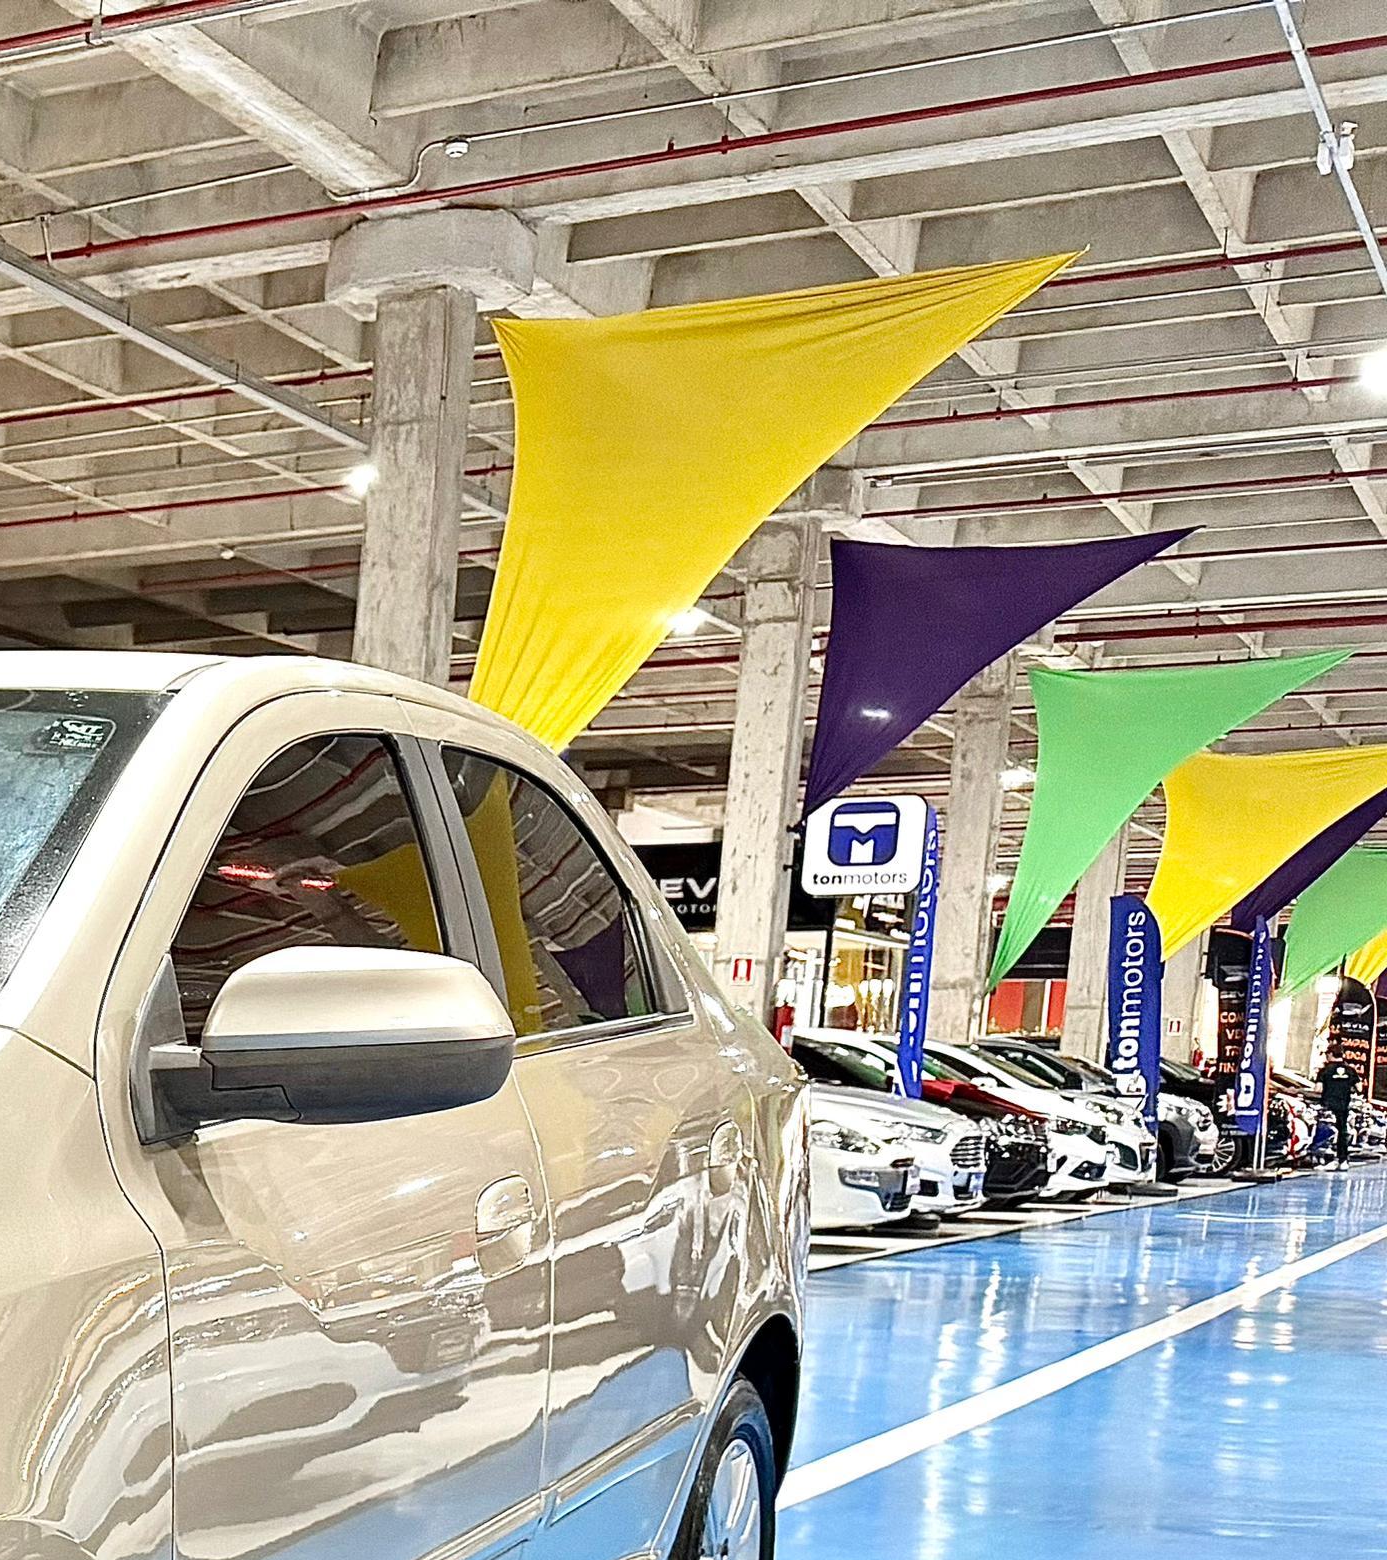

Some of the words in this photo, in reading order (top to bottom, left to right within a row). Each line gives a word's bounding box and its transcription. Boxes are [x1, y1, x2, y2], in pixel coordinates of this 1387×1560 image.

[654, 877, 717, 899] EV
[813, 872, 907, 885] tonmotors
[1112, 911, 1146, 1070] tonmotors
